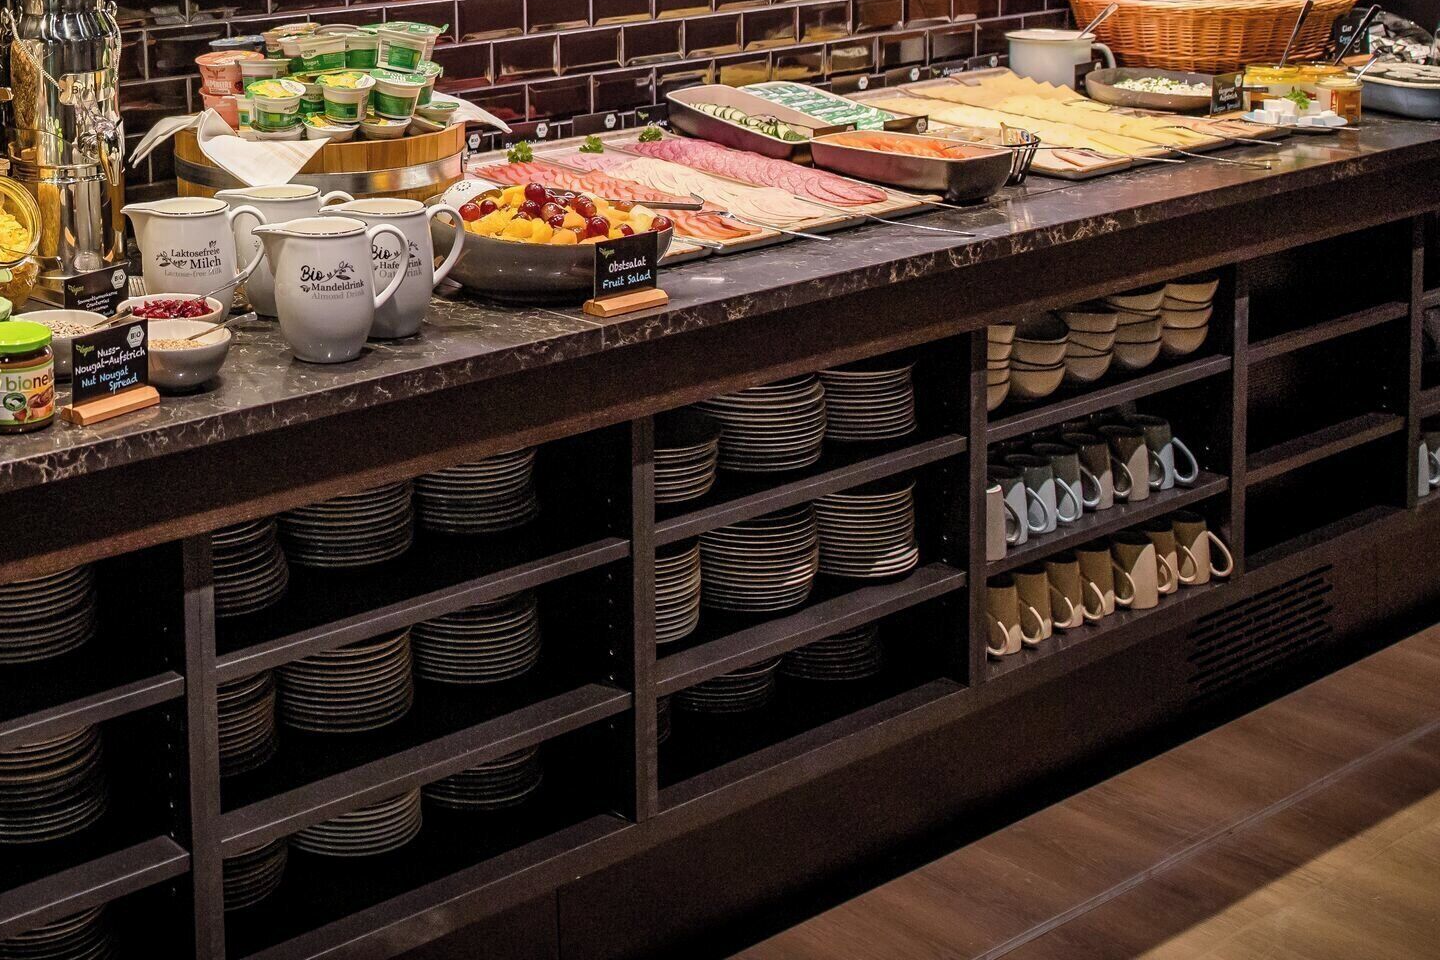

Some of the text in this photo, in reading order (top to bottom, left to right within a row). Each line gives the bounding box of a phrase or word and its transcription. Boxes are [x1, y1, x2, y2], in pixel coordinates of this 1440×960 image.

[171, 247, 220, 258] Laktosefreie
[190, 255, 222, 269] Milch
[608, 255, 647, 273] Obstsalat
[300, 265, 324, 282] Bio
[602, 269, 652, 289] Fruit Salad
[311, 279, 365, 292] Mandeldrink
[311, 290, 345, 300] Almond
[97, 346, 120, 358] Nuss-
[74, 346, 146, 376] Nougat-Aufstrich
[81, 365, 129, 388] Nut Nougat
[109, 372, 138, 394] Spread
